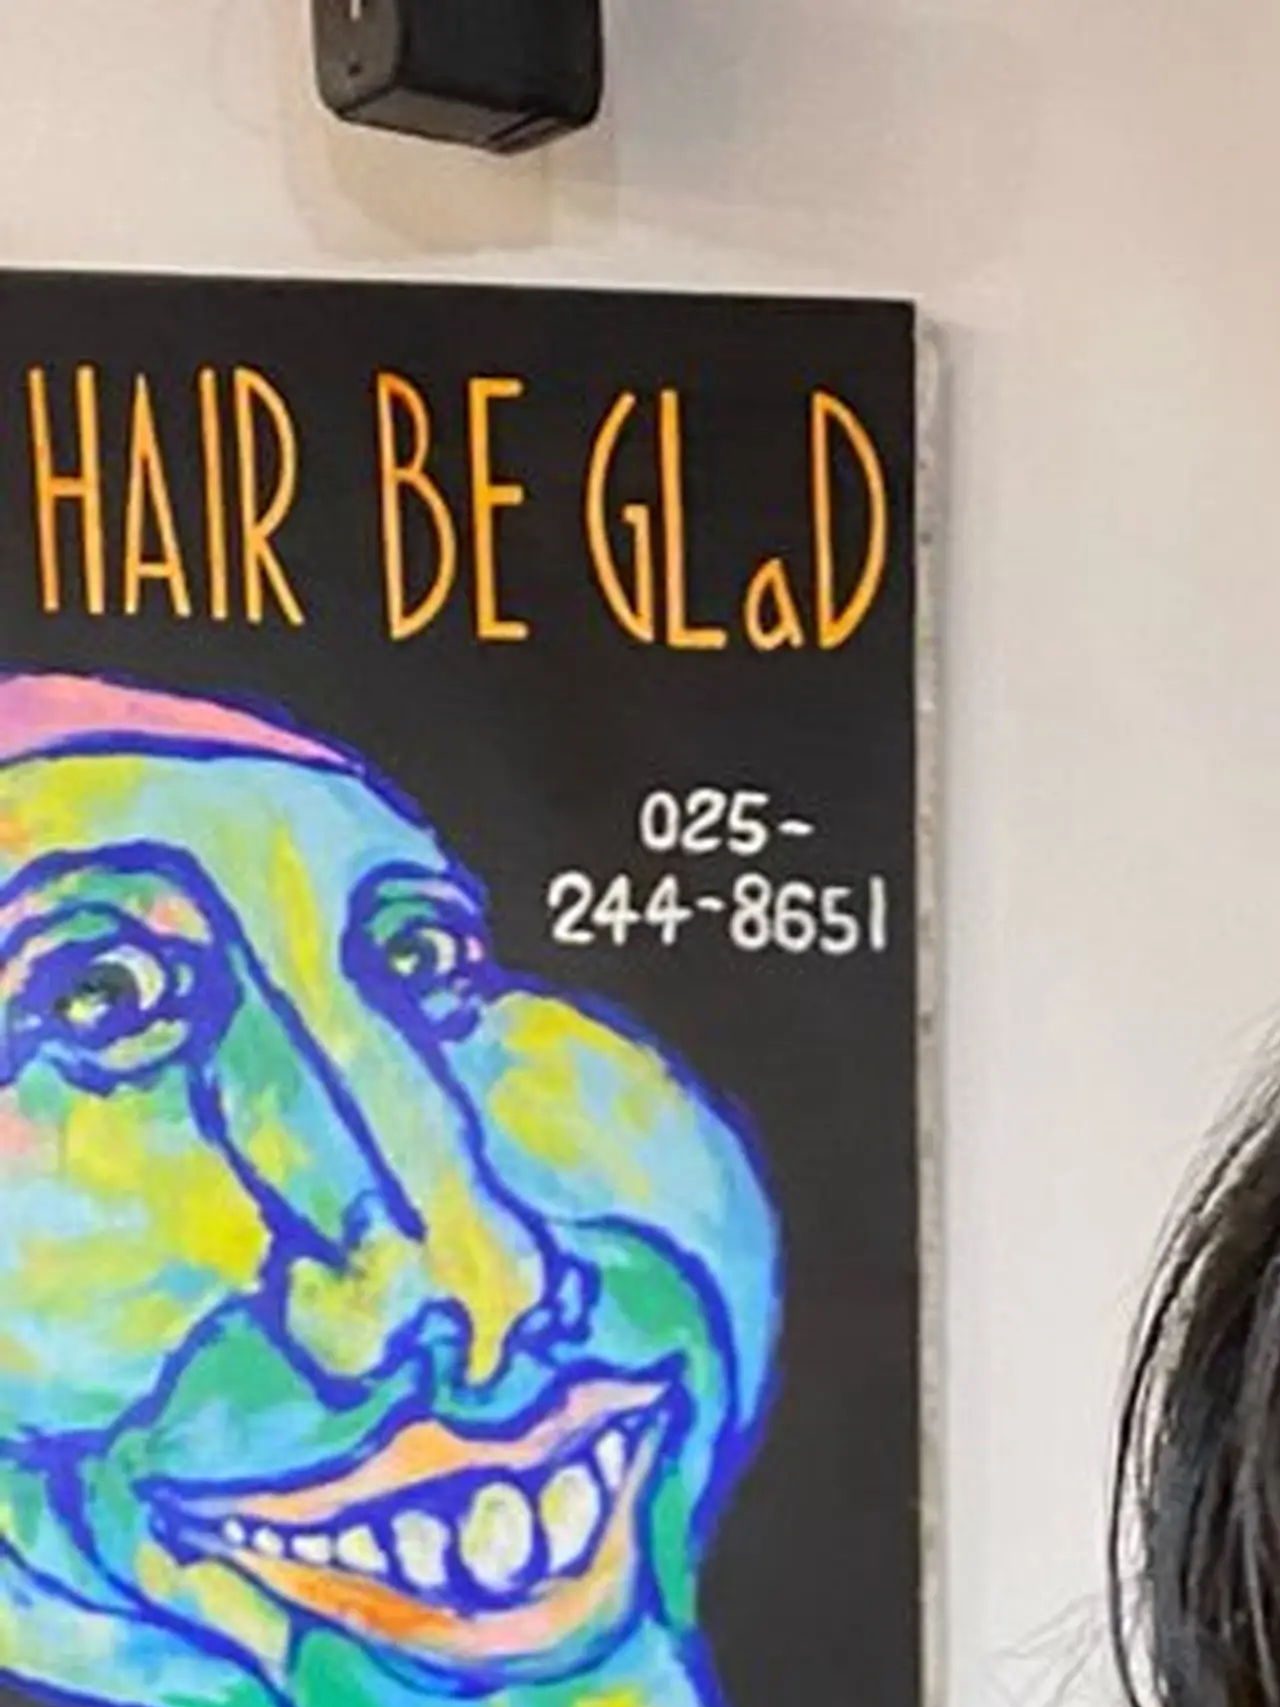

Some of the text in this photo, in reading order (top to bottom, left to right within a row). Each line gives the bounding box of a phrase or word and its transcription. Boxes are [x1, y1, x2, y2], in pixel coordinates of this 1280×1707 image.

[27, 365, 306, 625] HAIR
[375, 370, 530, 641] BE
[640, 789, 815, 857] 025-
[547, 871, 888, 953] 244-8651
